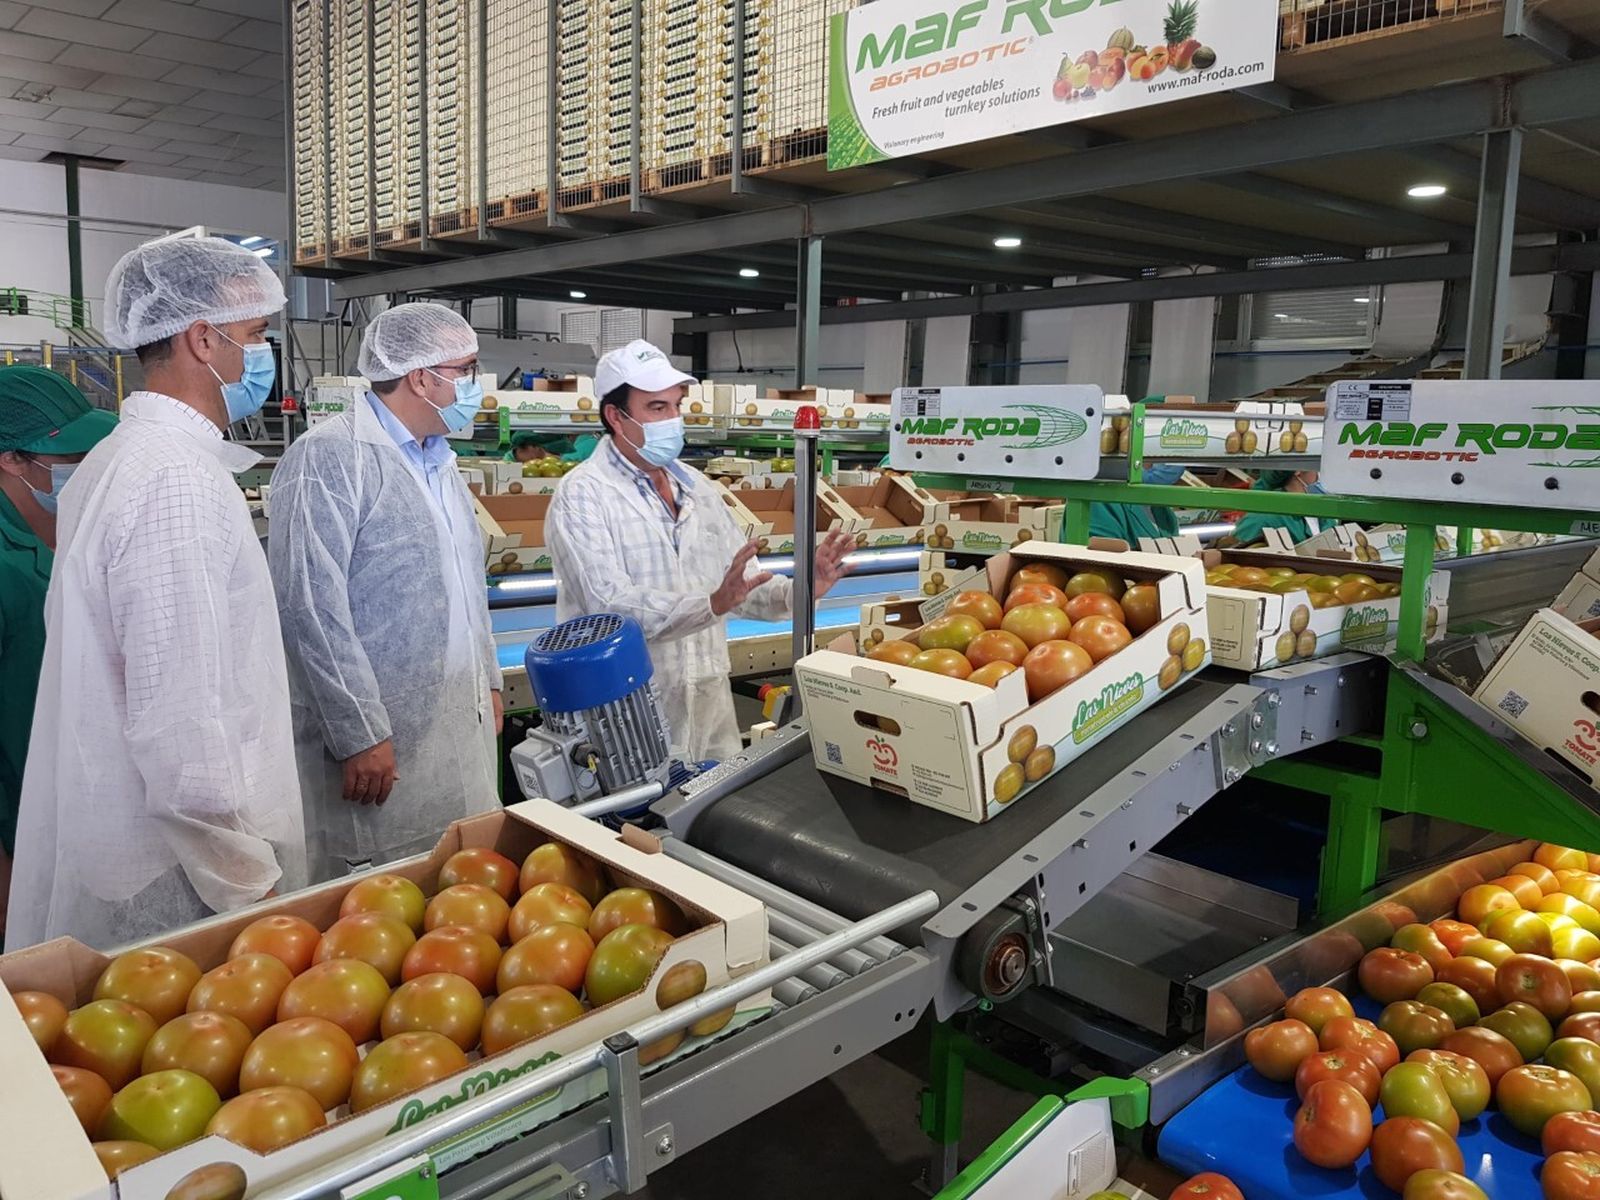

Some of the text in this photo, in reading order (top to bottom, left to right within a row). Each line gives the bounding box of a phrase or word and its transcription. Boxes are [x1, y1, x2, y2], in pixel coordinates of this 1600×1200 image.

[1148, 60, 1264, 94] www.maf-roda.com
[872, 78, 1004, 119] Fresh fruit and vegetables
[945, 87, 1040, 118] turnkey solutions
[909, 130, 944, 146] engineering
[1565, 739, 1597, 764] TOMATE
